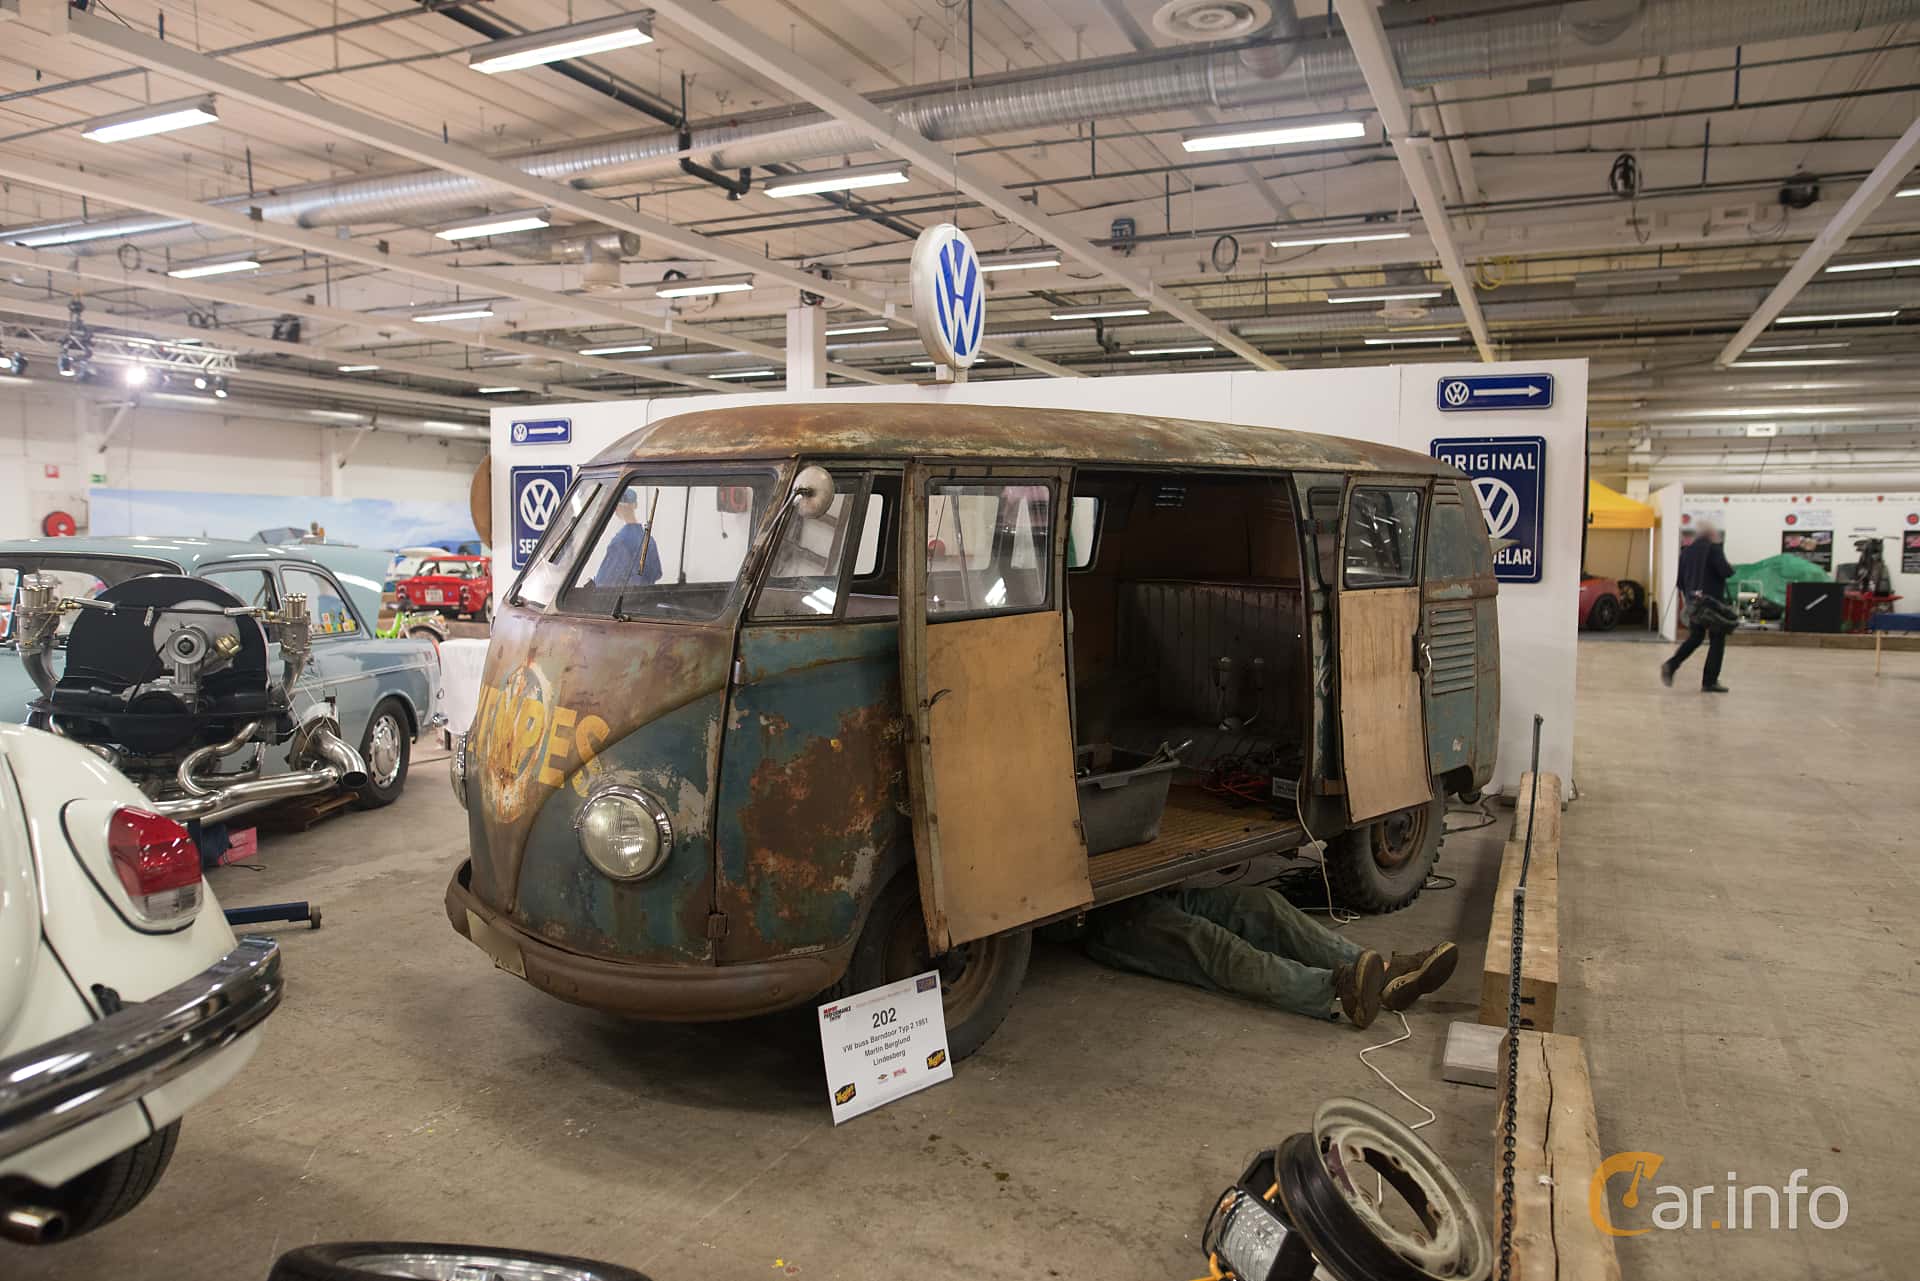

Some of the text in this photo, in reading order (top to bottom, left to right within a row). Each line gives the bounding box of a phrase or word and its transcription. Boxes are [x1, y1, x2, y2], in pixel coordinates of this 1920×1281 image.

[934, 234, 983, 360] VW
[1444, 381, 1470, 406] VW
[1440, 452, 1536, 471] ORIGINAL
[520, 478, 561, 531] VW
[872, 1007, 897, 1029] 202
[842, 1041, 853, 1054] VW
[854, 1038, 869, 1050] buss
[870, 1028, 897, 1045] Barndoor
[898, 1024, 910, 1036] Typ
[909, 1022, 915, 1030] 2
[864, 1035, 911, 1057] Martin Berglund
[872, 1050, 906, 1066] Lindesberg
